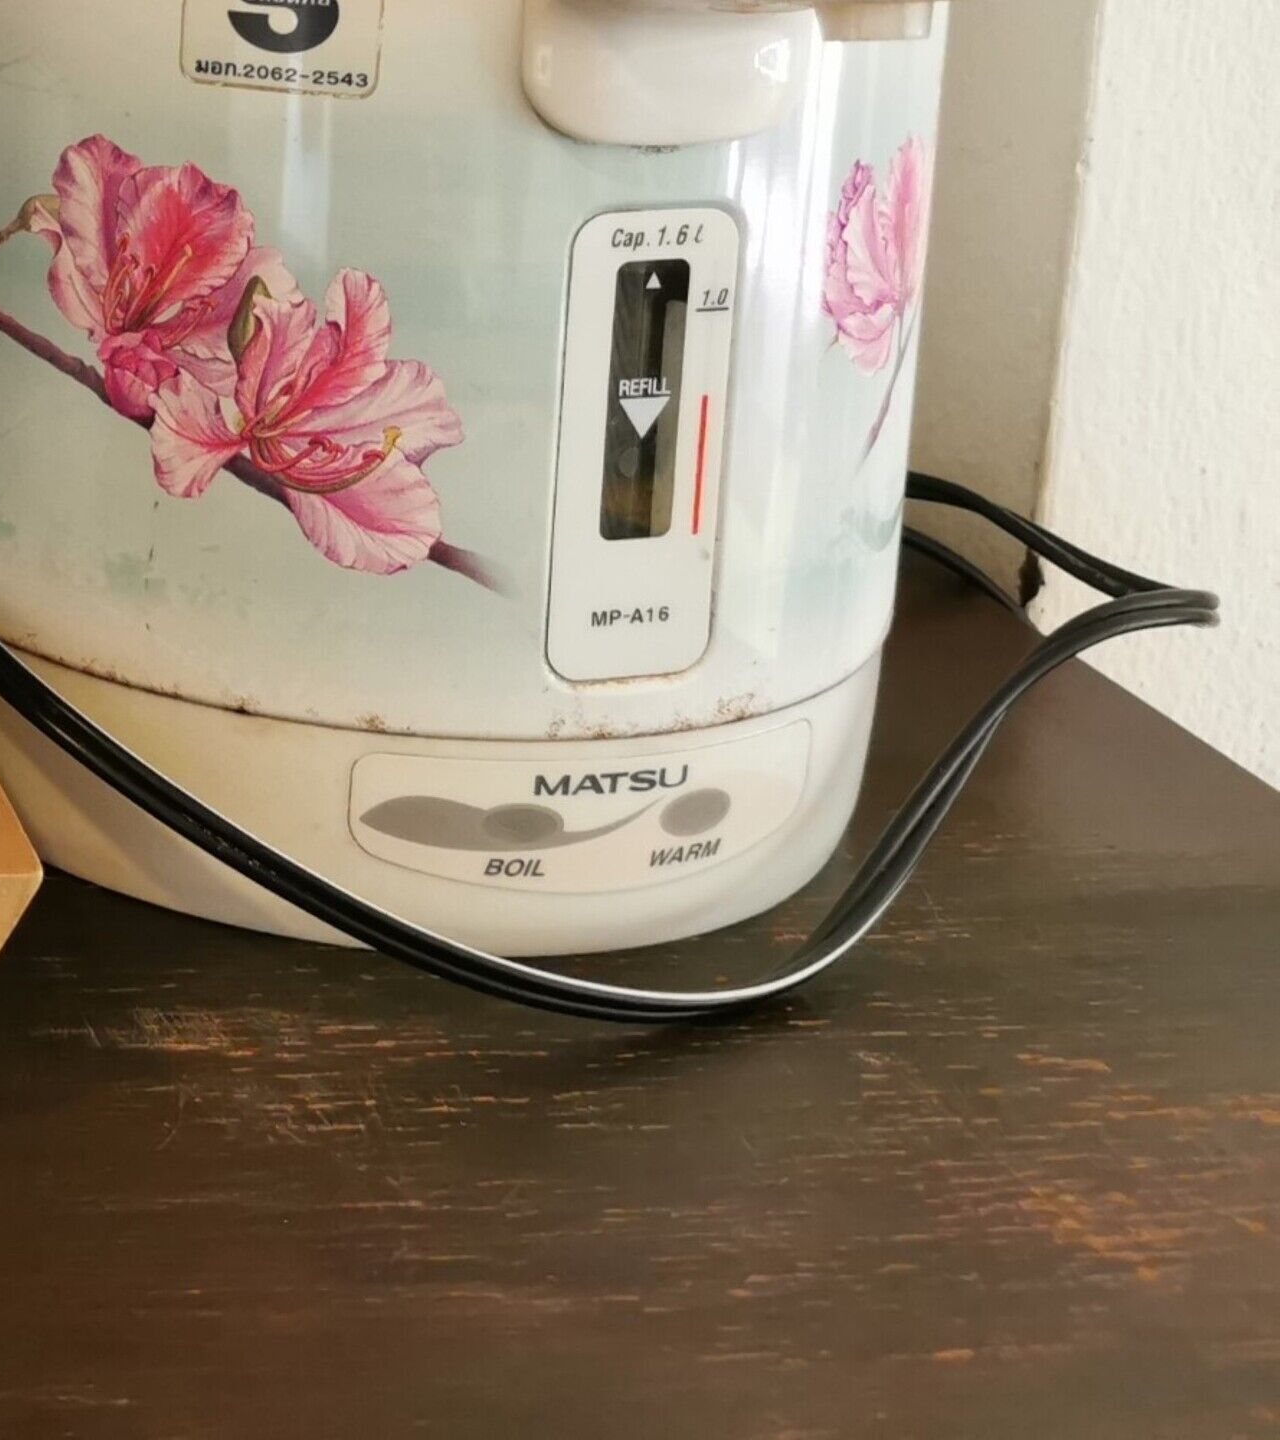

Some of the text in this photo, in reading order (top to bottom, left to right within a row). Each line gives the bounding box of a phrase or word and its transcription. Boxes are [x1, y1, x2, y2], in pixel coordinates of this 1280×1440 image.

[195, 59, 369, 88] มอก.2062-2543
[611, 227, 652, 249] Cap.
[701, 288, 729, 306] 1.0
[618, 377, 671, 397] REFILL
[591, 606, 670, 628] MP-A16
[533, 765, 689, 796] MATSU
[649, 838, 722, 867] WARM
[484, 859, 545, 877] BOIL
